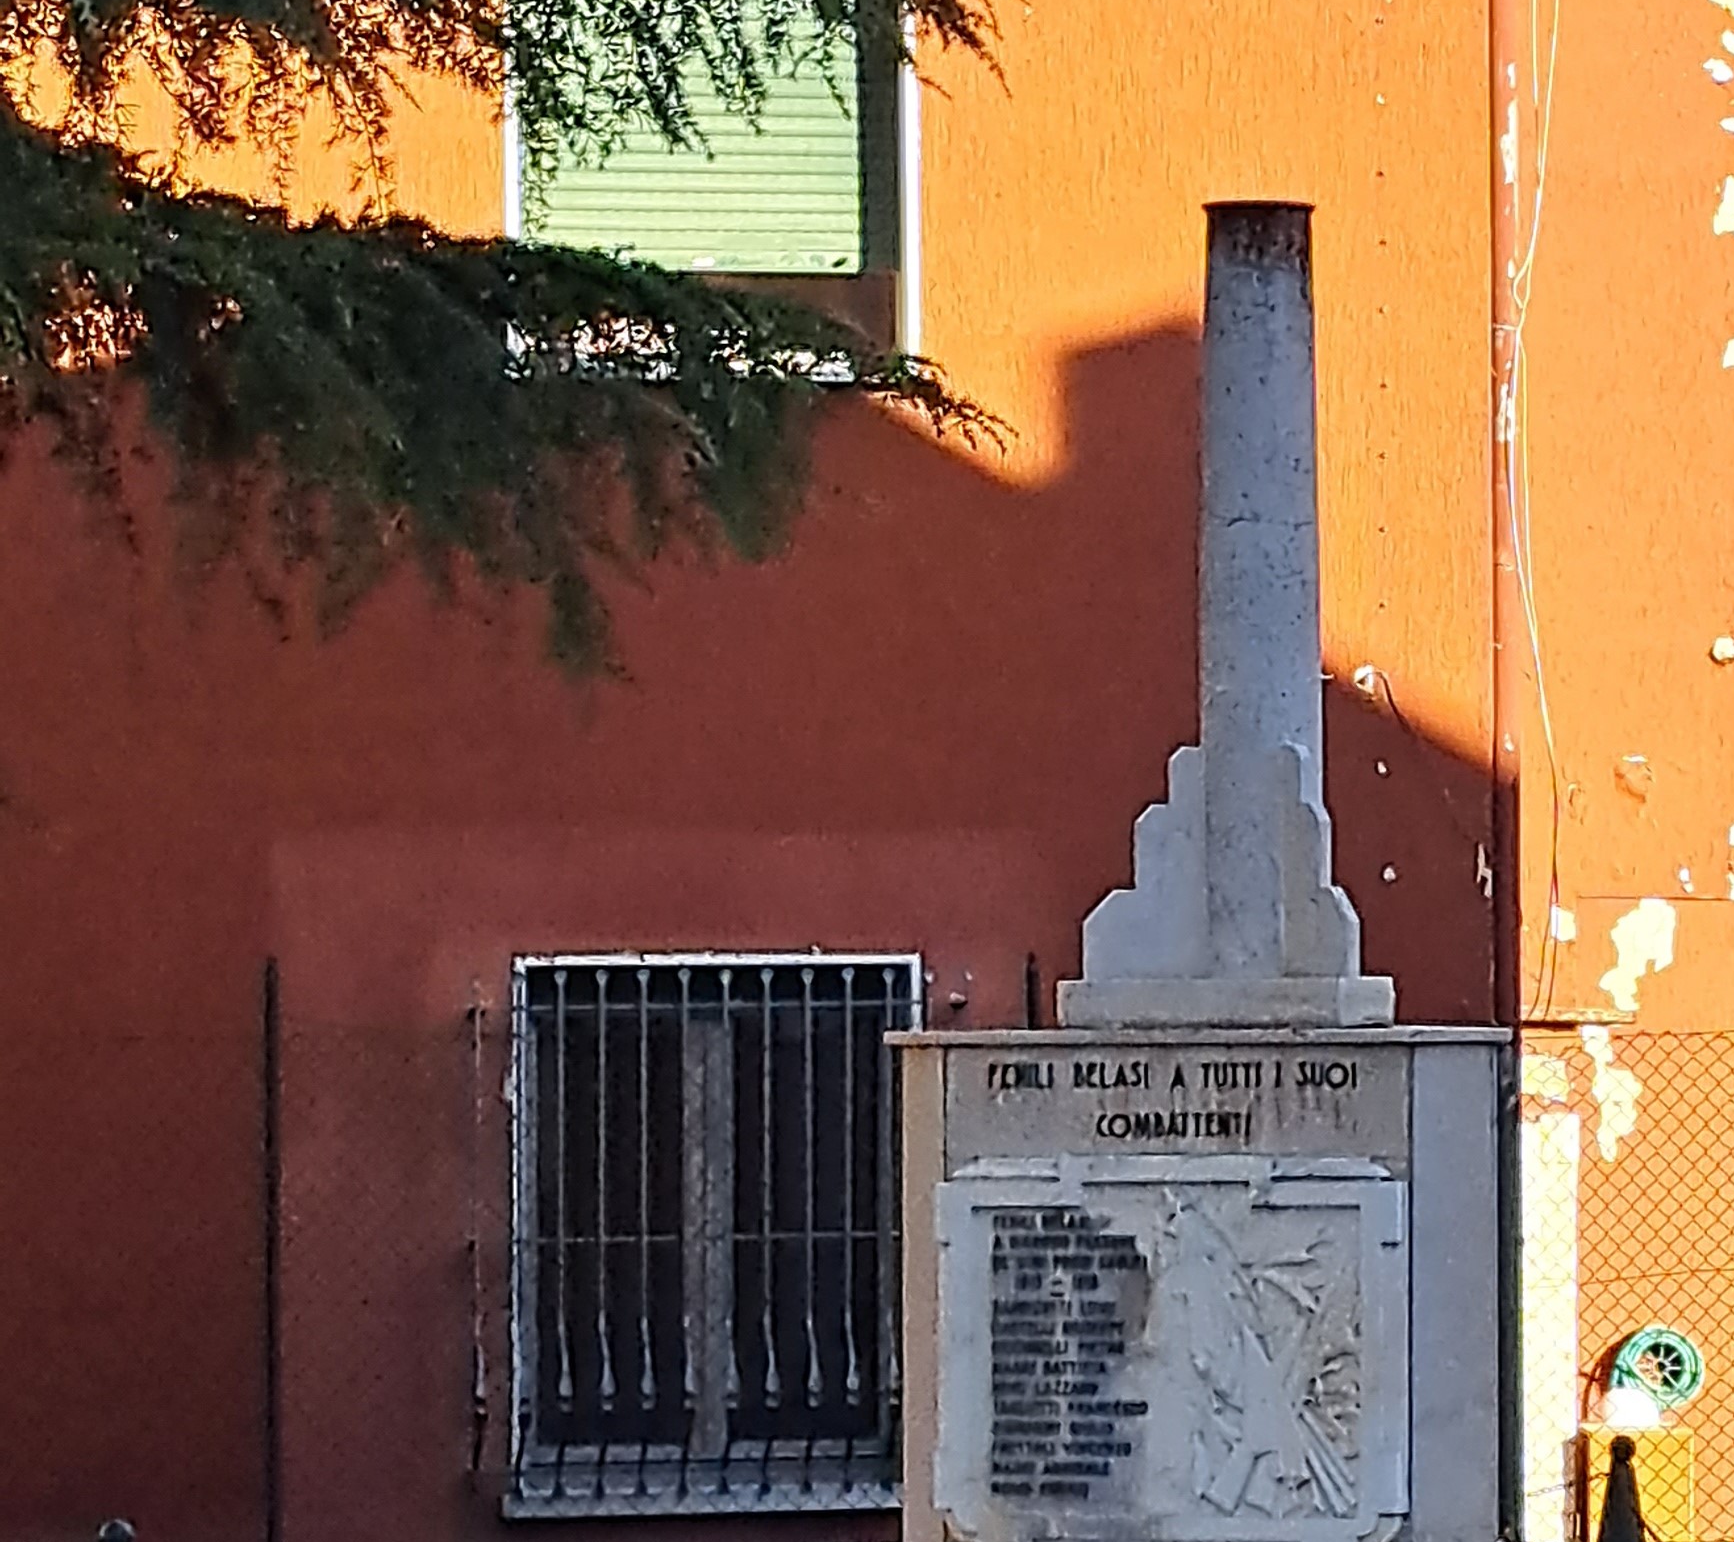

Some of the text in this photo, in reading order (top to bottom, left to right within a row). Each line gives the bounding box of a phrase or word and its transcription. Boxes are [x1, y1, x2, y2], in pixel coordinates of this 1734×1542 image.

[1073, 1060, 1149, 1090] BELASI
[1170, 1062, 1187, 1093] A
[1201, 1061, 1262, 1091] TUTTI
[1274, 1061, 1282, 1089] I
[1295, 1061, 1357, 1090] SUOI
[1096, 1110, 1251, 1142] COMBATTENTI
